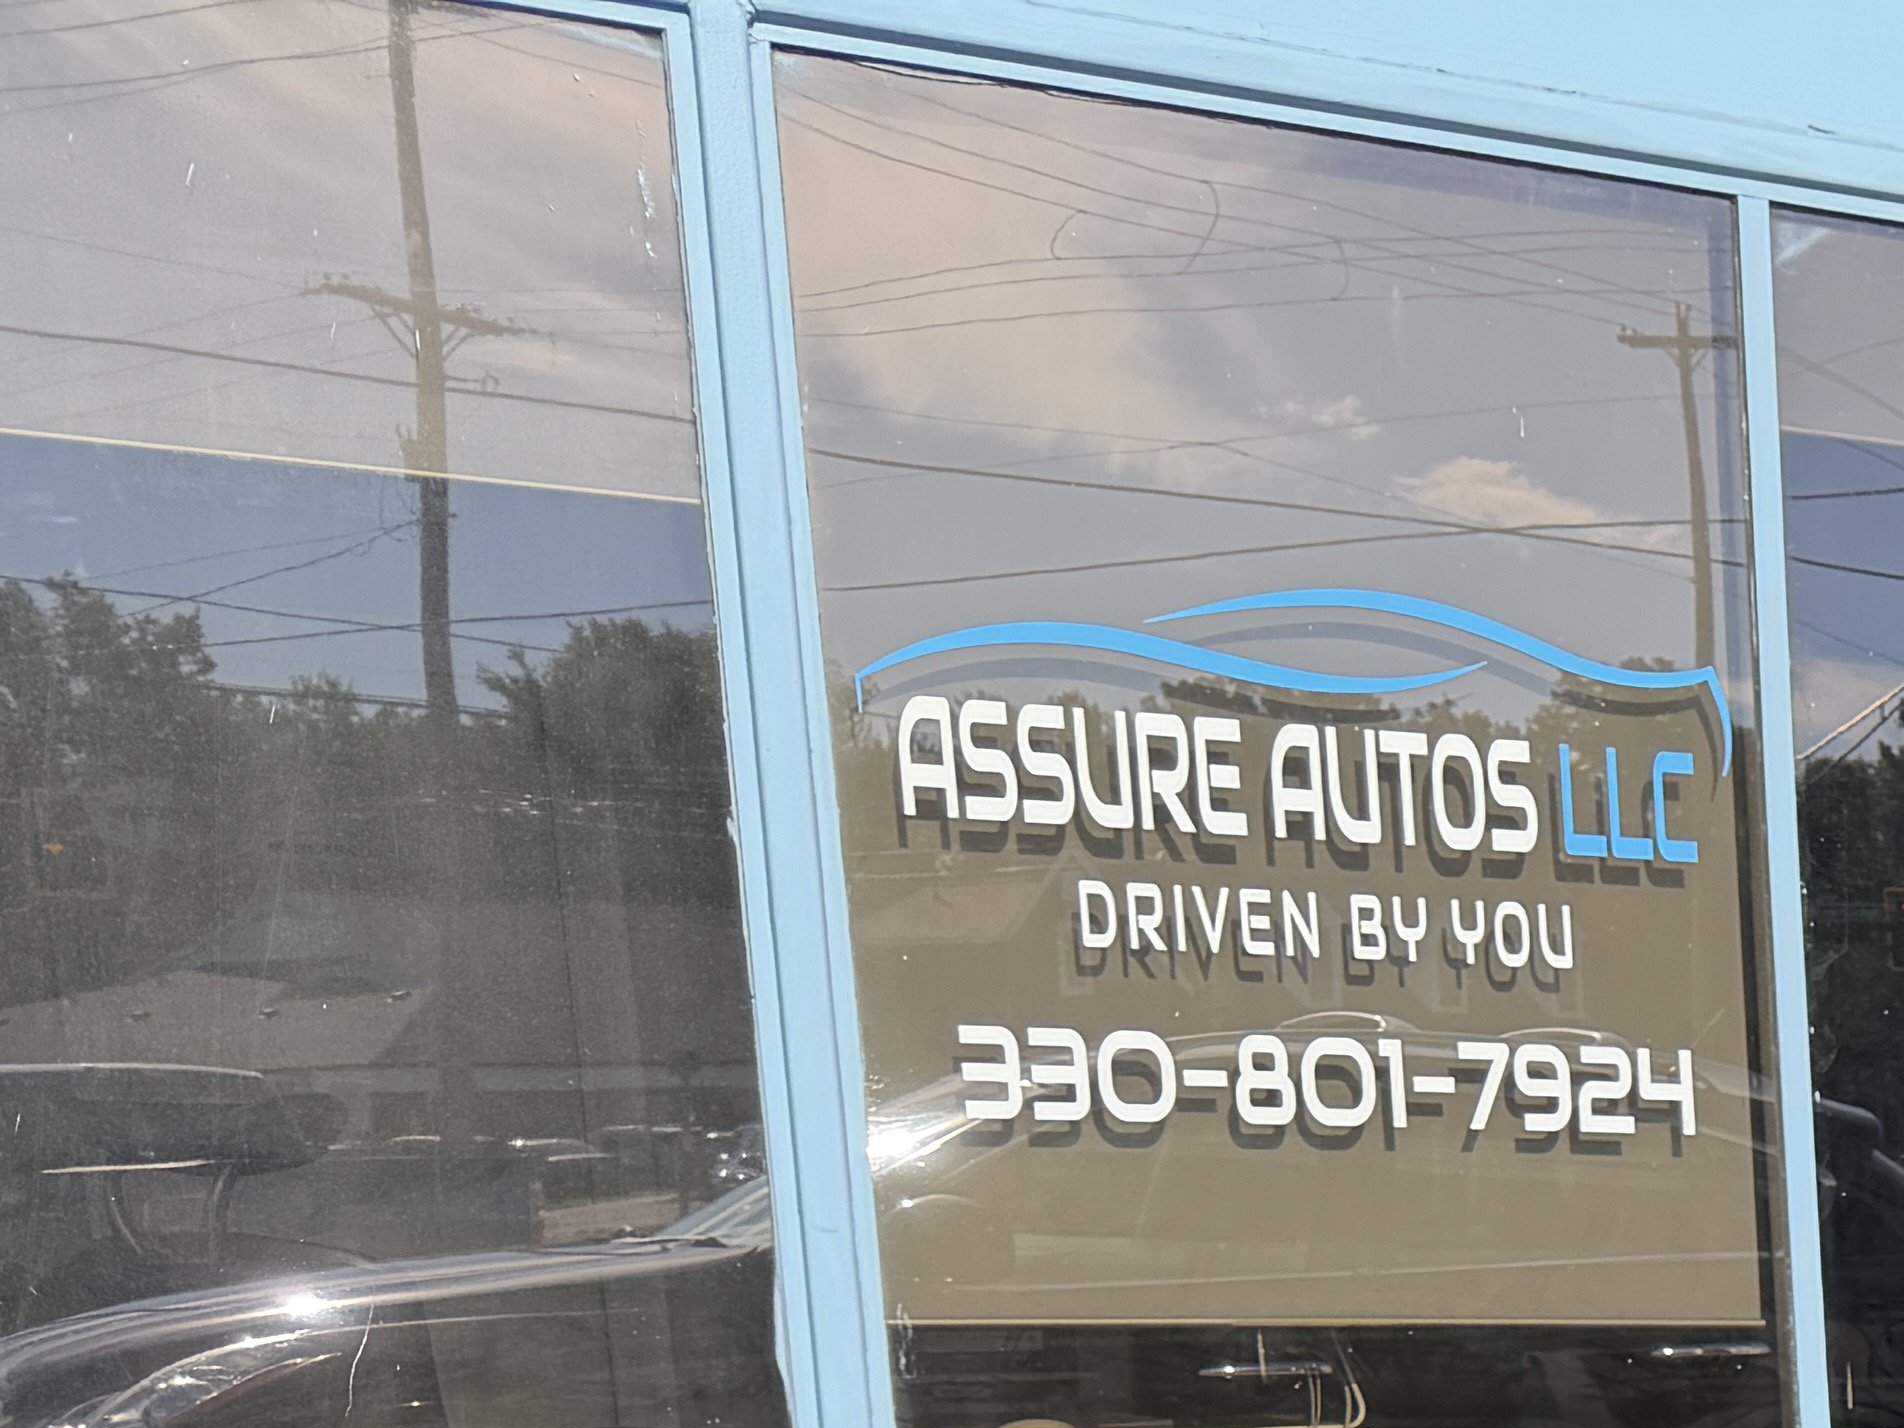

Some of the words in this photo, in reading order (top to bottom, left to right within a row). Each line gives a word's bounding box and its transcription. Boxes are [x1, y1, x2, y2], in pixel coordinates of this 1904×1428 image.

[897, 695, 1249, 837] ASSURE
[1271, 722, 1539, 854] AUTOS
[1558, 743, 1699, 864] LLC
[1078, 880, 1321, 958] DRIVEN
[1351, 893, 1430, 964] BY
[1451, 900, 1574, 970] YOU
[957, 1023, 1697, 1138] 330-801-7924
